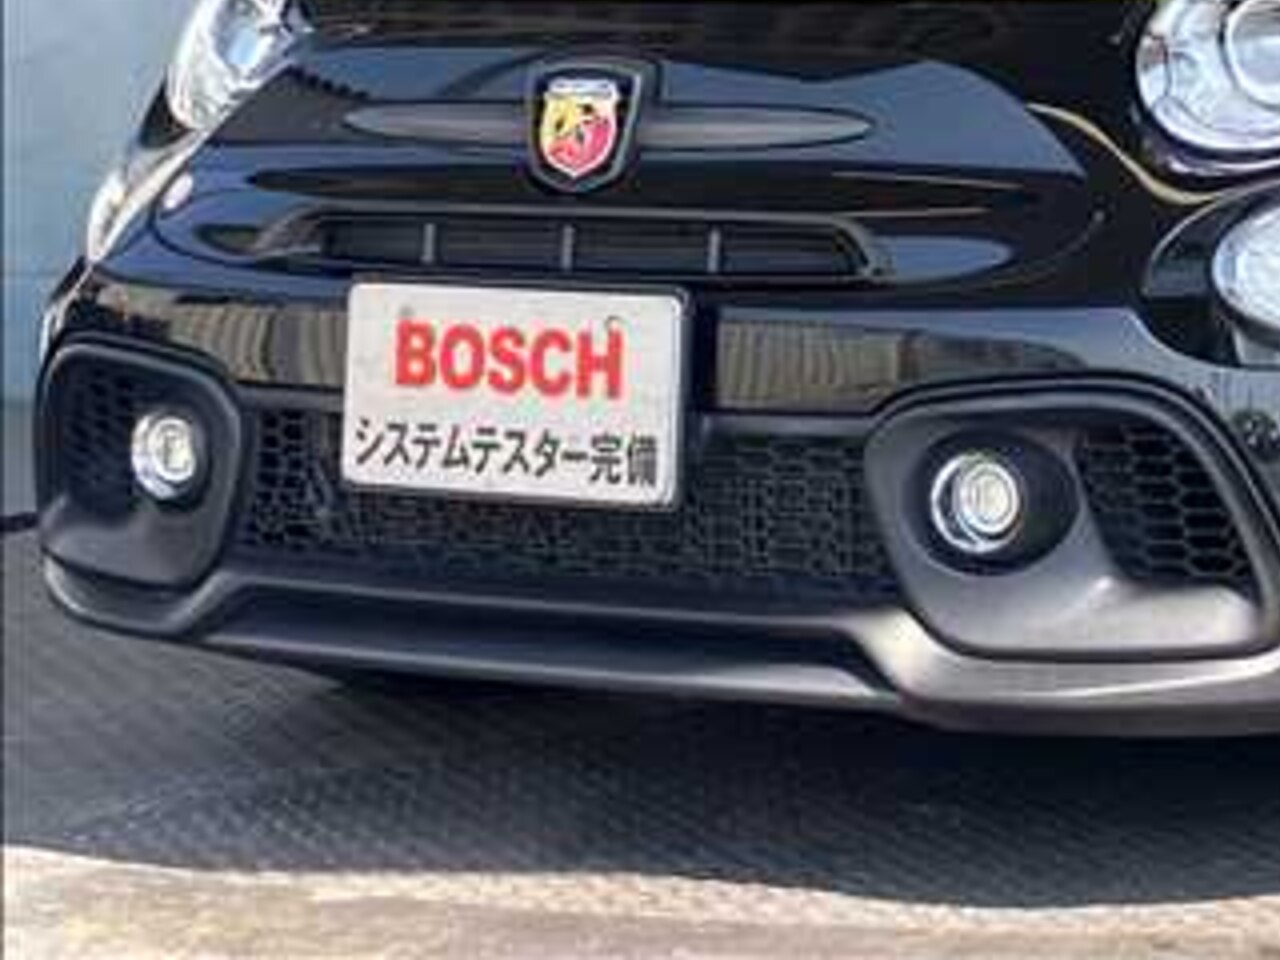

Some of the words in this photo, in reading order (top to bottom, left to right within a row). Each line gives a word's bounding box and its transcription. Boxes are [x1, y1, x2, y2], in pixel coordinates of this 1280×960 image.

[394, 319, 625, 399] BOSCH
[355, 418, 659, 487] システムテスター完備
